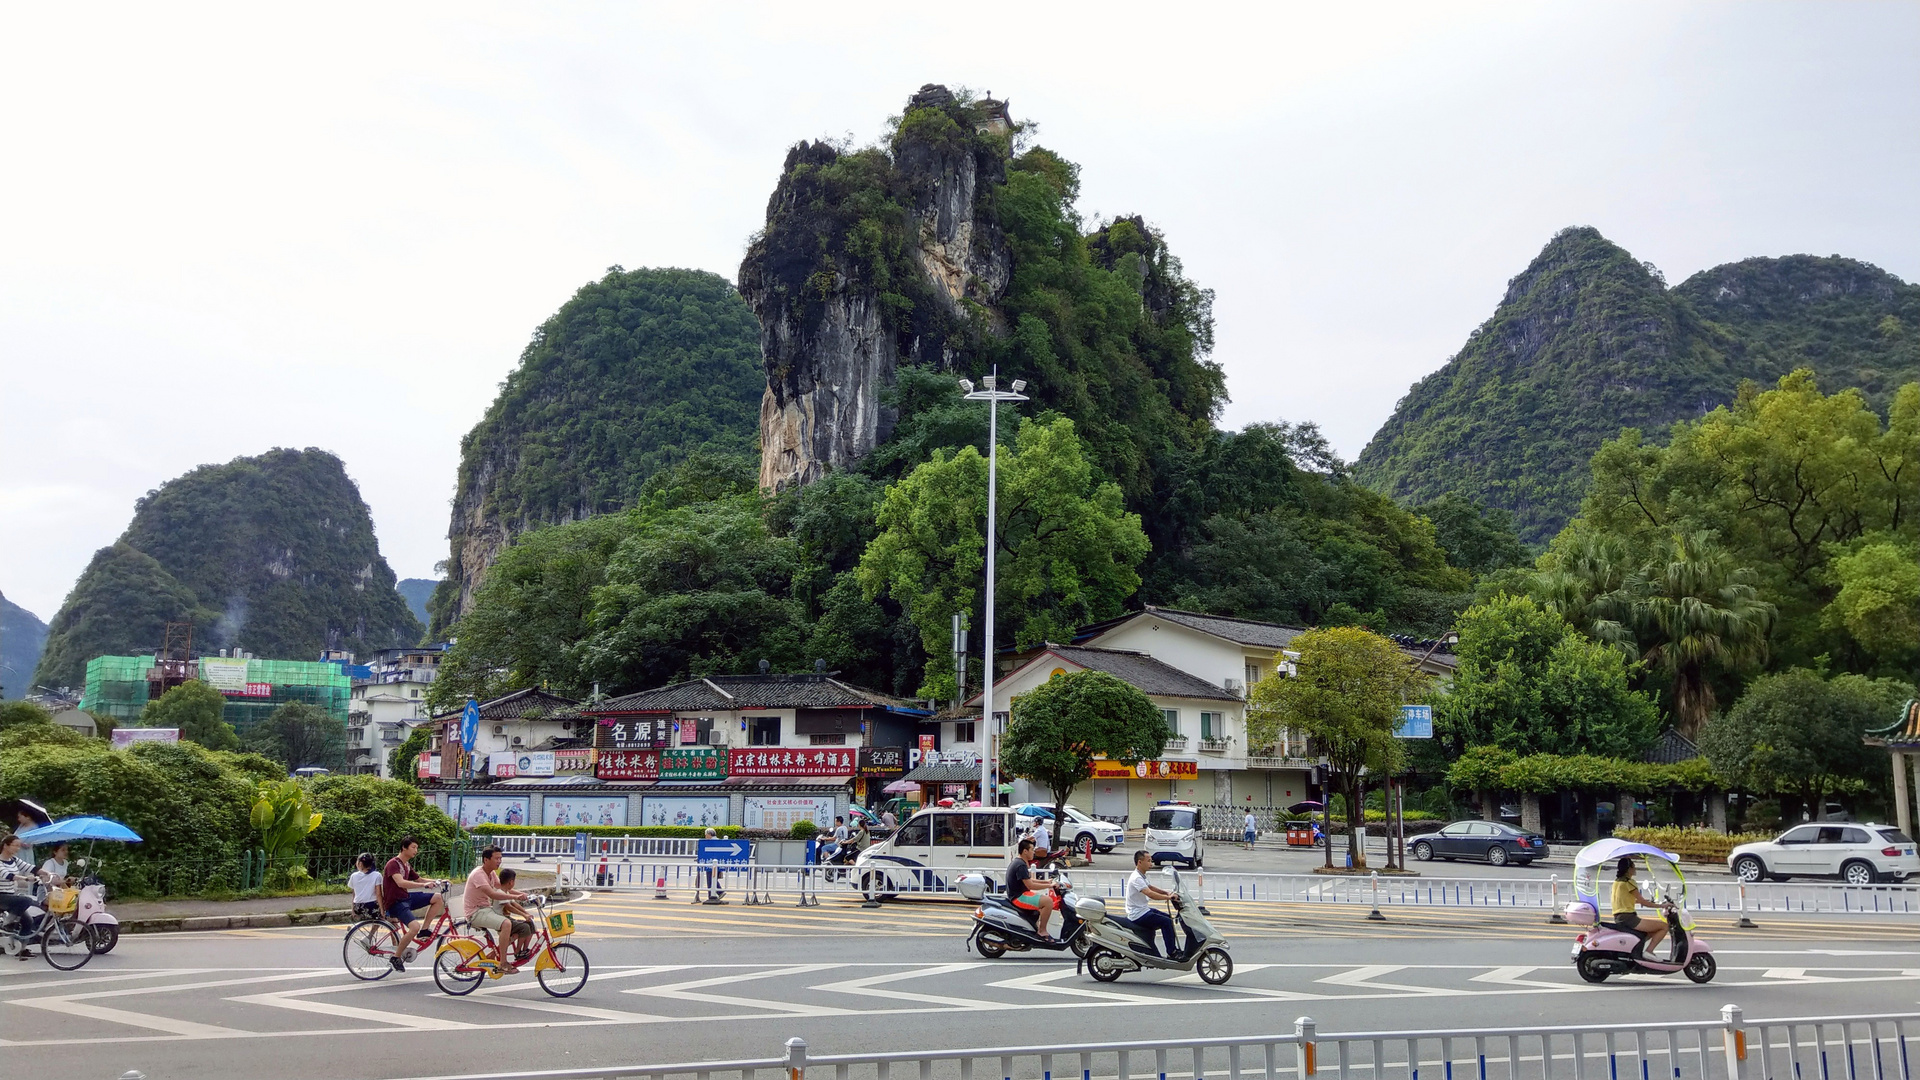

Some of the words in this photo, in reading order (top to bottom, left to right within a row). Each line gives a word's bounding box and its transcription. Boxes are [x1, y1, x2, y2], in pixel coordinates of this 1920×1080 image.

[611, 722, 651, 741] 名源
[1415, 721, 1430, 731] 出口
[598, 753, 658, 769] 桂林米粉
[662, 756, 718, 769] 桂林米粉
[734, 751, 851, 768] 正宗桂林米粉·啤酒鱼
[870, 751, 894, 765] 名源
[909, 748, 922, 769] P
[925, 749, 977, 768] 停车场
